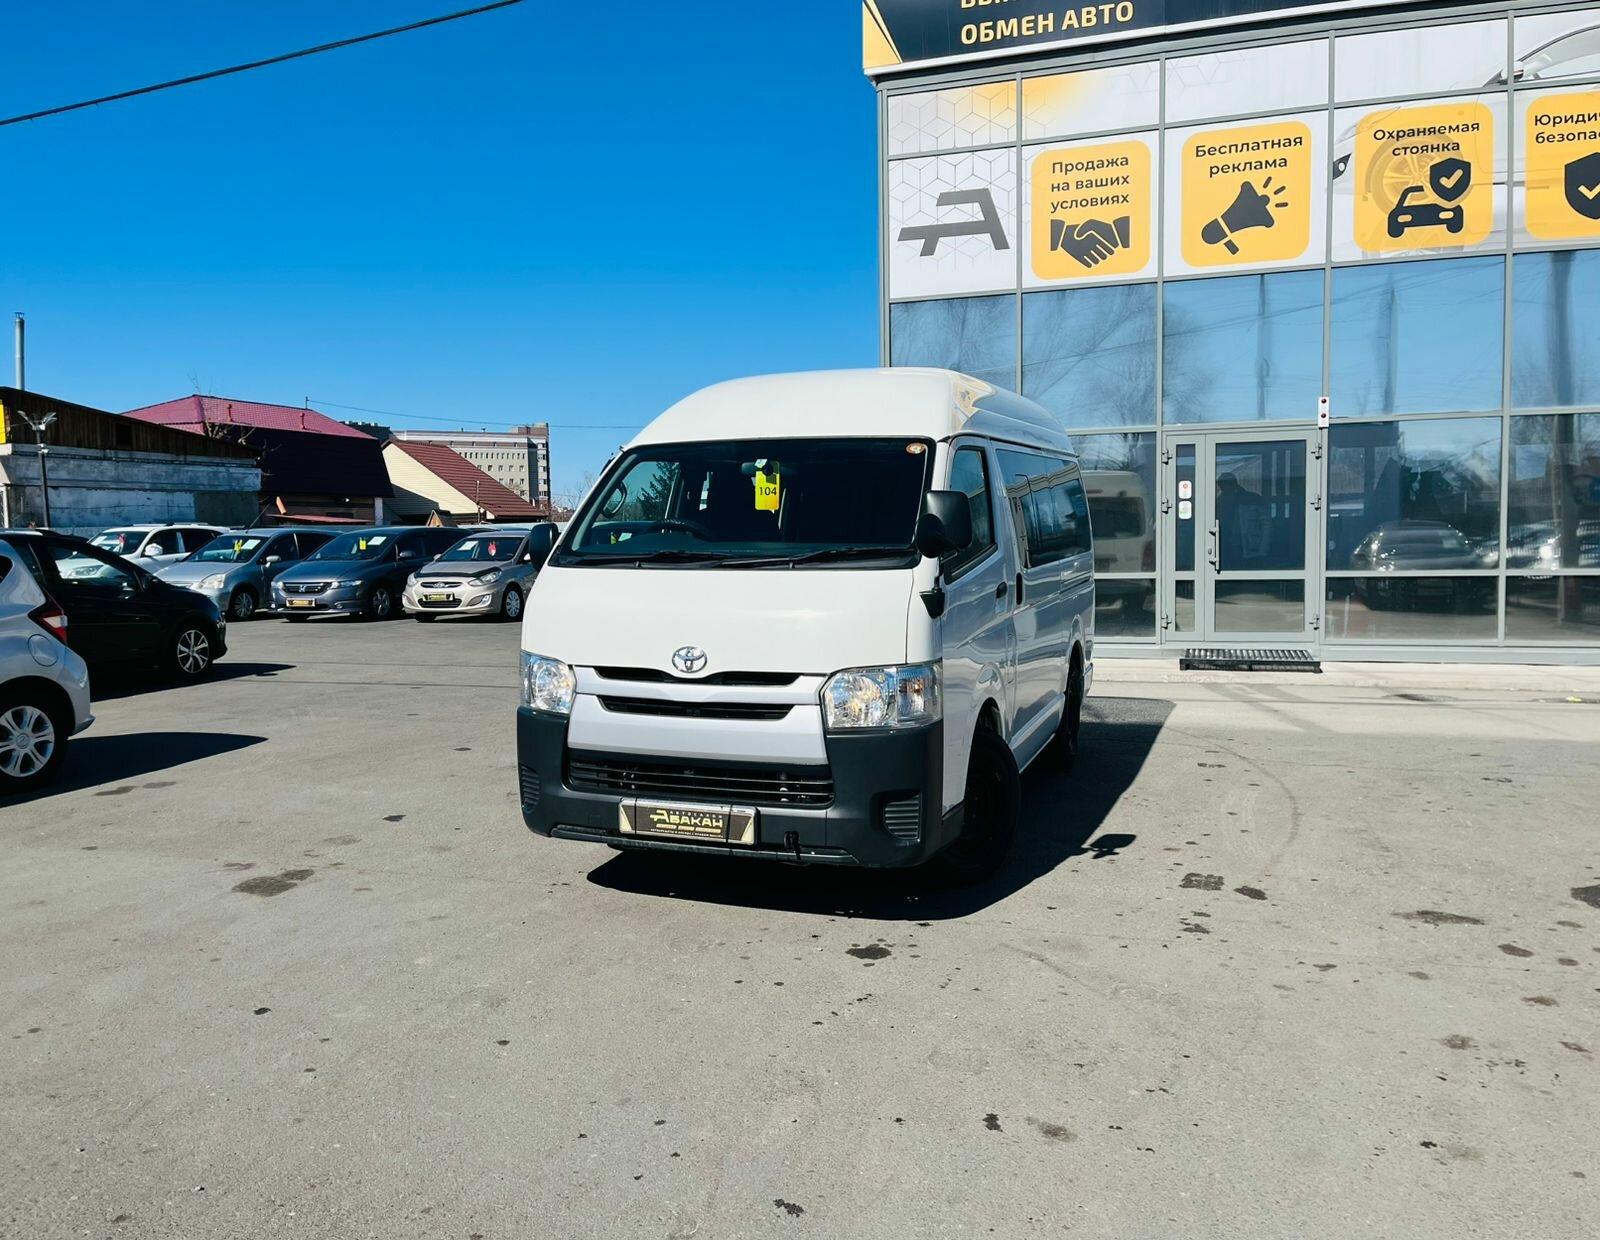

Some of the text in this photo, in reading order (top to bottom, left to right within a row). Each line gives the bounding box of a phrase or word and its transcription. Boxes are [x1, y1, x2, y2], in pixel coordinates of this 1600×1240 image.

[961, 1, 1134, 45] ОБМЕН АВТО
[1534, 112, 1600, 127] Юриди
[1373, 122, 1480, 141] Охраняемая
[1535, 131, 1600, 144] безопа
[1195, 136, 1303, 157] Бесплатная
[1392, 142, 1460, 157] стоянка
[1052, 156, 1129, 175] Продажа
[1209, 157, 1288, 178] реклама
[1051, 175, 1130, 192] на ваших
[1050, 194, 1130, 213] условиях
[759, 486, 777, 496] 104
[649, 809, 723, 828] АБАКАН
